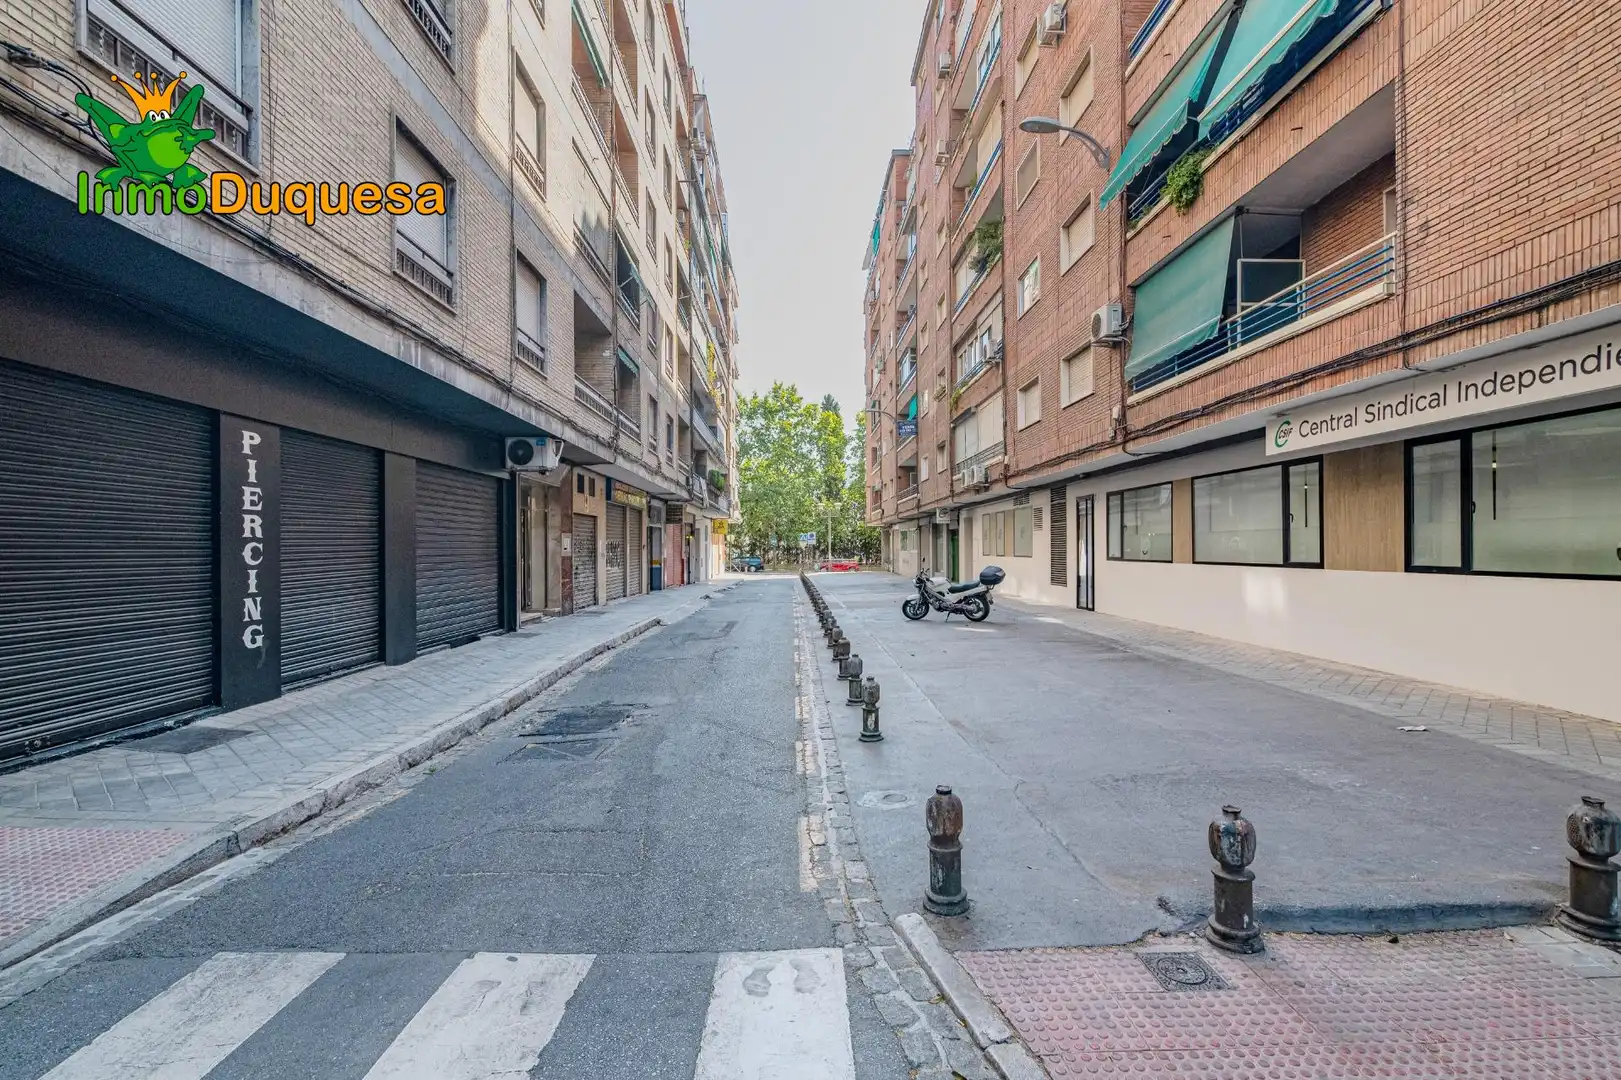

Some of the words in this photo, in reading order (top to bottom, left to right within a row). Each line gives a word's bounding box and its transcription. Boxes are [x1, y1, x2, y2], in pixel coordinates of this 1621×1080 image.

[1299, 407, 1358, 437] Central
[1364, 384, 1447, 423] Sindical
[1457, 343, 1621, 403] Independi
[241, 430, 264, 650] PIERCING
